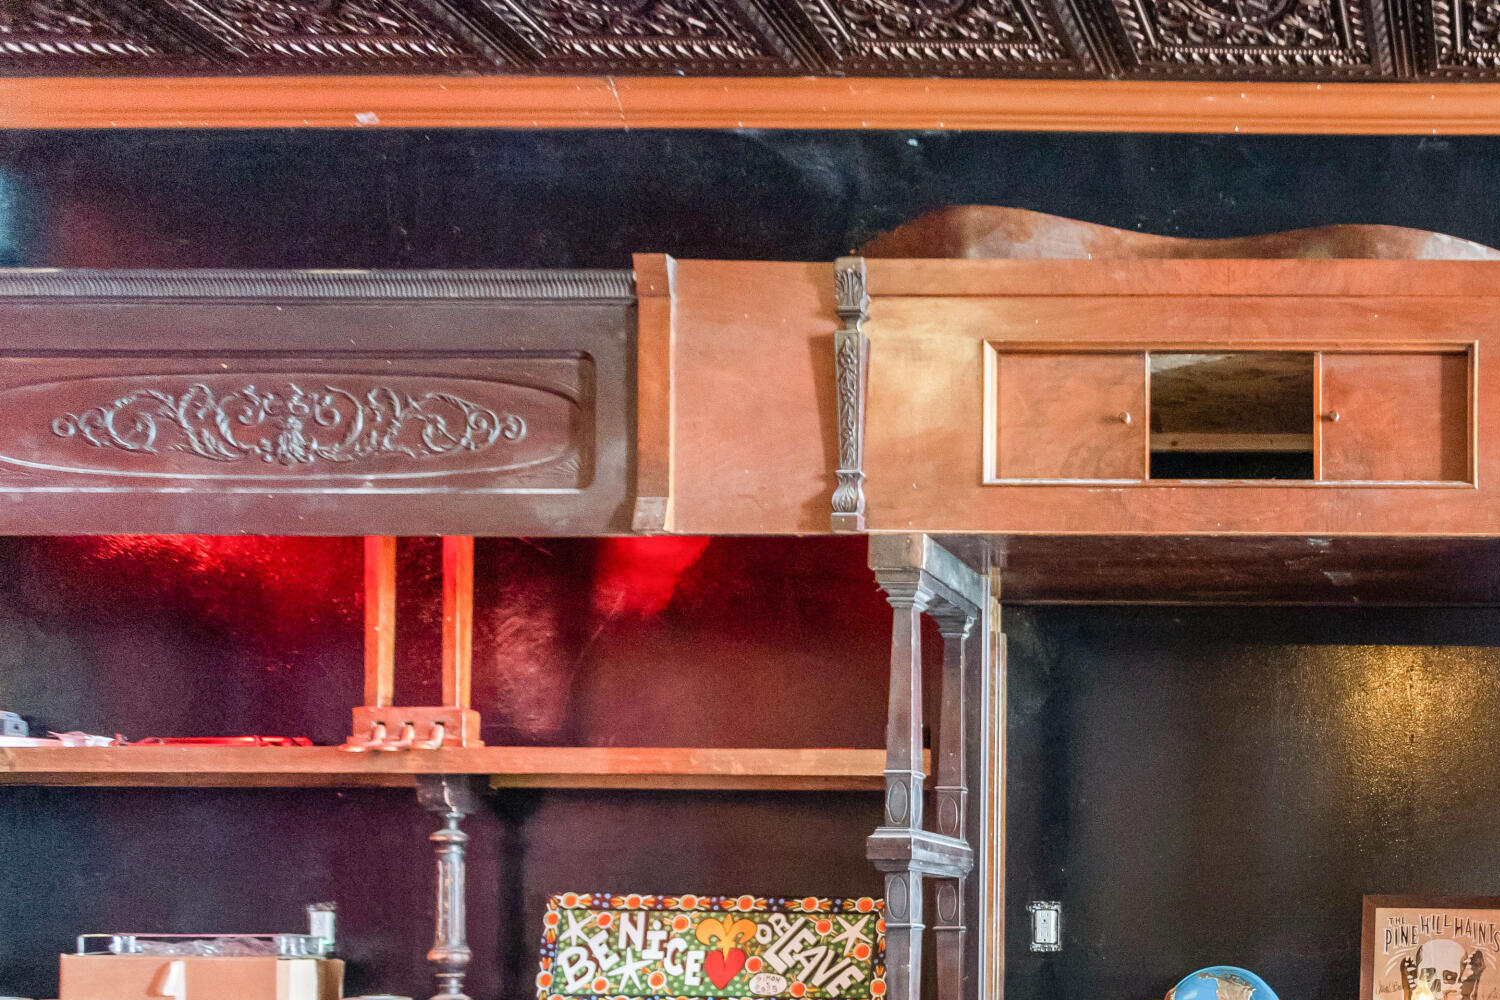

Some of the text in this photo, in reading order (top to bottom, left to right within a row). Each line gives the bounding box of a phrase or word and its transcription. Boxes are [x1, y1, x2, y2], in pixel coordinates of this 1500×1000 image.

[1384, 914, 1500, 953] PINE HILL HAINTS
[1388, 916, 1405, 925] THE
[557, 911, 865, 998] BE NICE OR LEAVE
